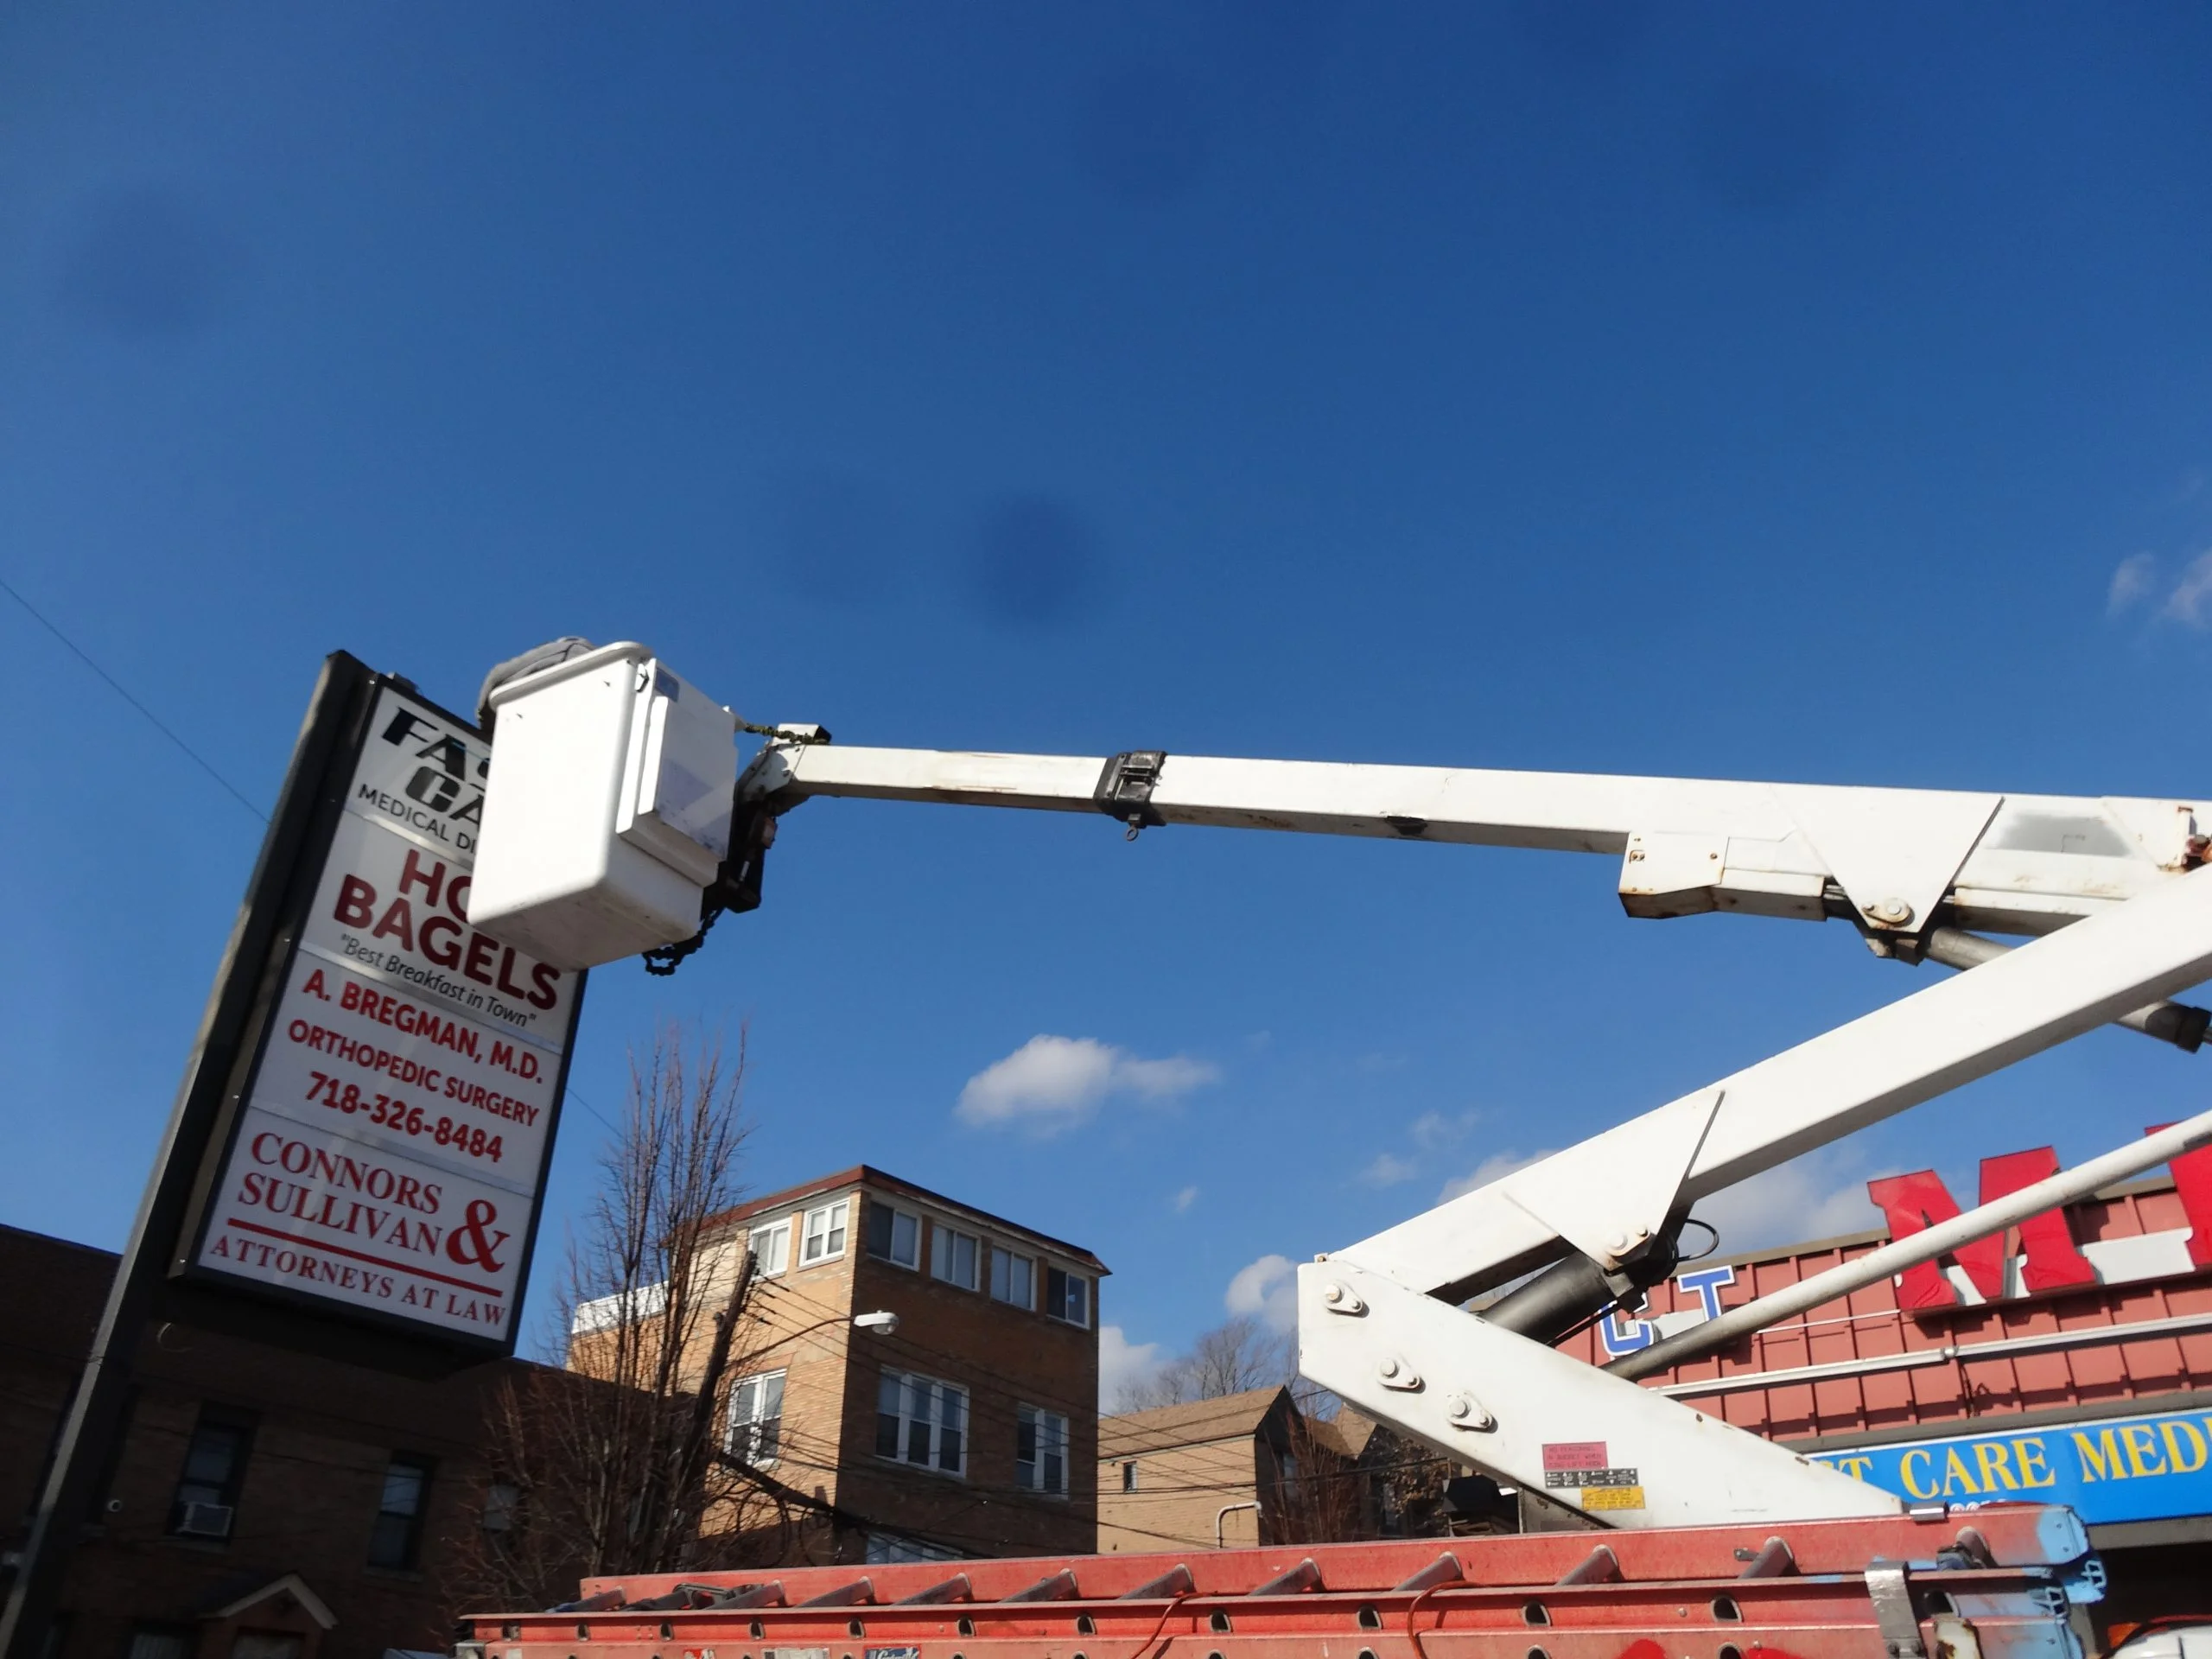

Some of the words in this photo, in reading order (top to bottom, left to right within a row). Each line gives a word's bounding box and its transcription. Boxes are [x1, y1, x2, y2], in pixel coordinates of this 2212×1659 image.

[357, 784, 449, 842] MEDICAL
[334, 874, 560, 1010] BAGELS
[385, 955, 467, 1001] Breakfast
[466, 988, 484, 1009] in
[302, 968, 331, 1001] A.
[340, 981, 483, 1064] BREGMAN,
[489, 1039, 543, 1084] M.D.
[289, 1019, 442, 1092] ORTHOPEDIC
[443, 1076, 540, 1127] SURGERY
[306, 1071, 503, 1163] 718-326-8484
[251, 1132, 443, 1214] CONNORS
[238, 1172, 443, 1256] SULLIVAN
[445, 1198, 512, 1274] &
[210, 1236, 394, 1299] ATTORNEYS
[401, 1284, 440, 1309] AT
[446, 1294, 507, 1326] LAW
[1900, 1437, 2056, 1500] CARE
[2070, 1417, 2212, 1483] MED
